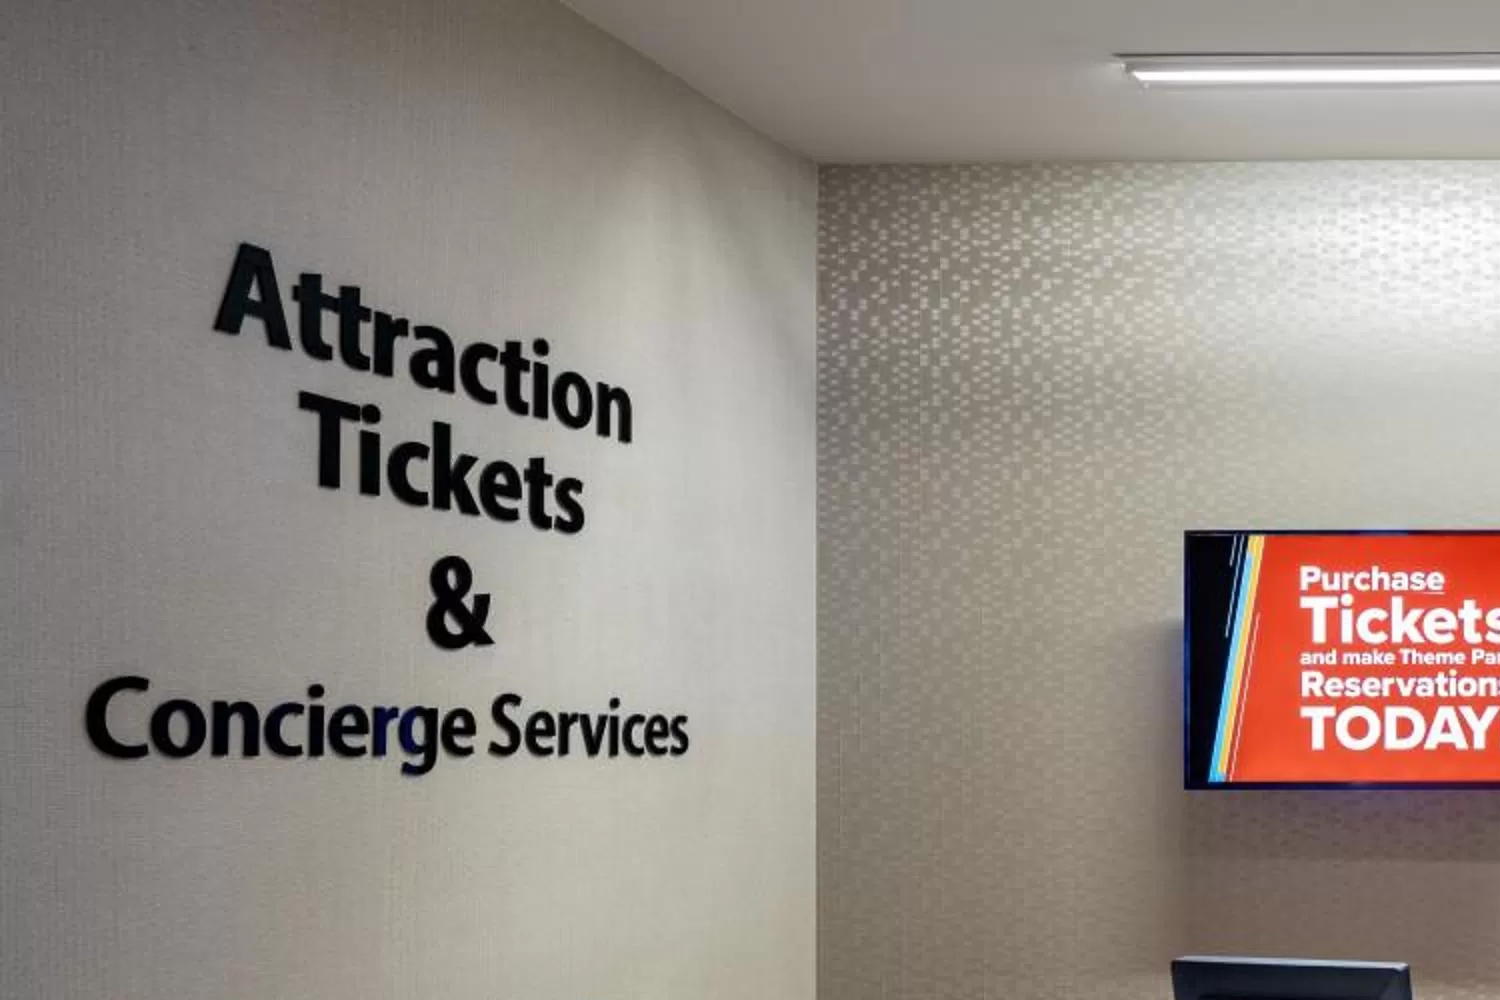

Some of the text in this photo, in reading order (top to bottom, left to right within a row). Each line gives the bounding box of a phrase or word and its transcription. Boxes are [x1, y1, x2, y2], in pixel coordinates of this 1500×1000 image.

[212, 242, 633, 444] Attraction
[298, 390, 585, 534] Tickets
[426, 555, 495, 650] &
[1300, 565, 1446, 592] Purchase
[1300, 648, 1338, 666] and
[1341, 648, 1397, 666] make
[1399, 648, 1467, 666] Theme
[84, 675, 690, 777] Concierge Services
